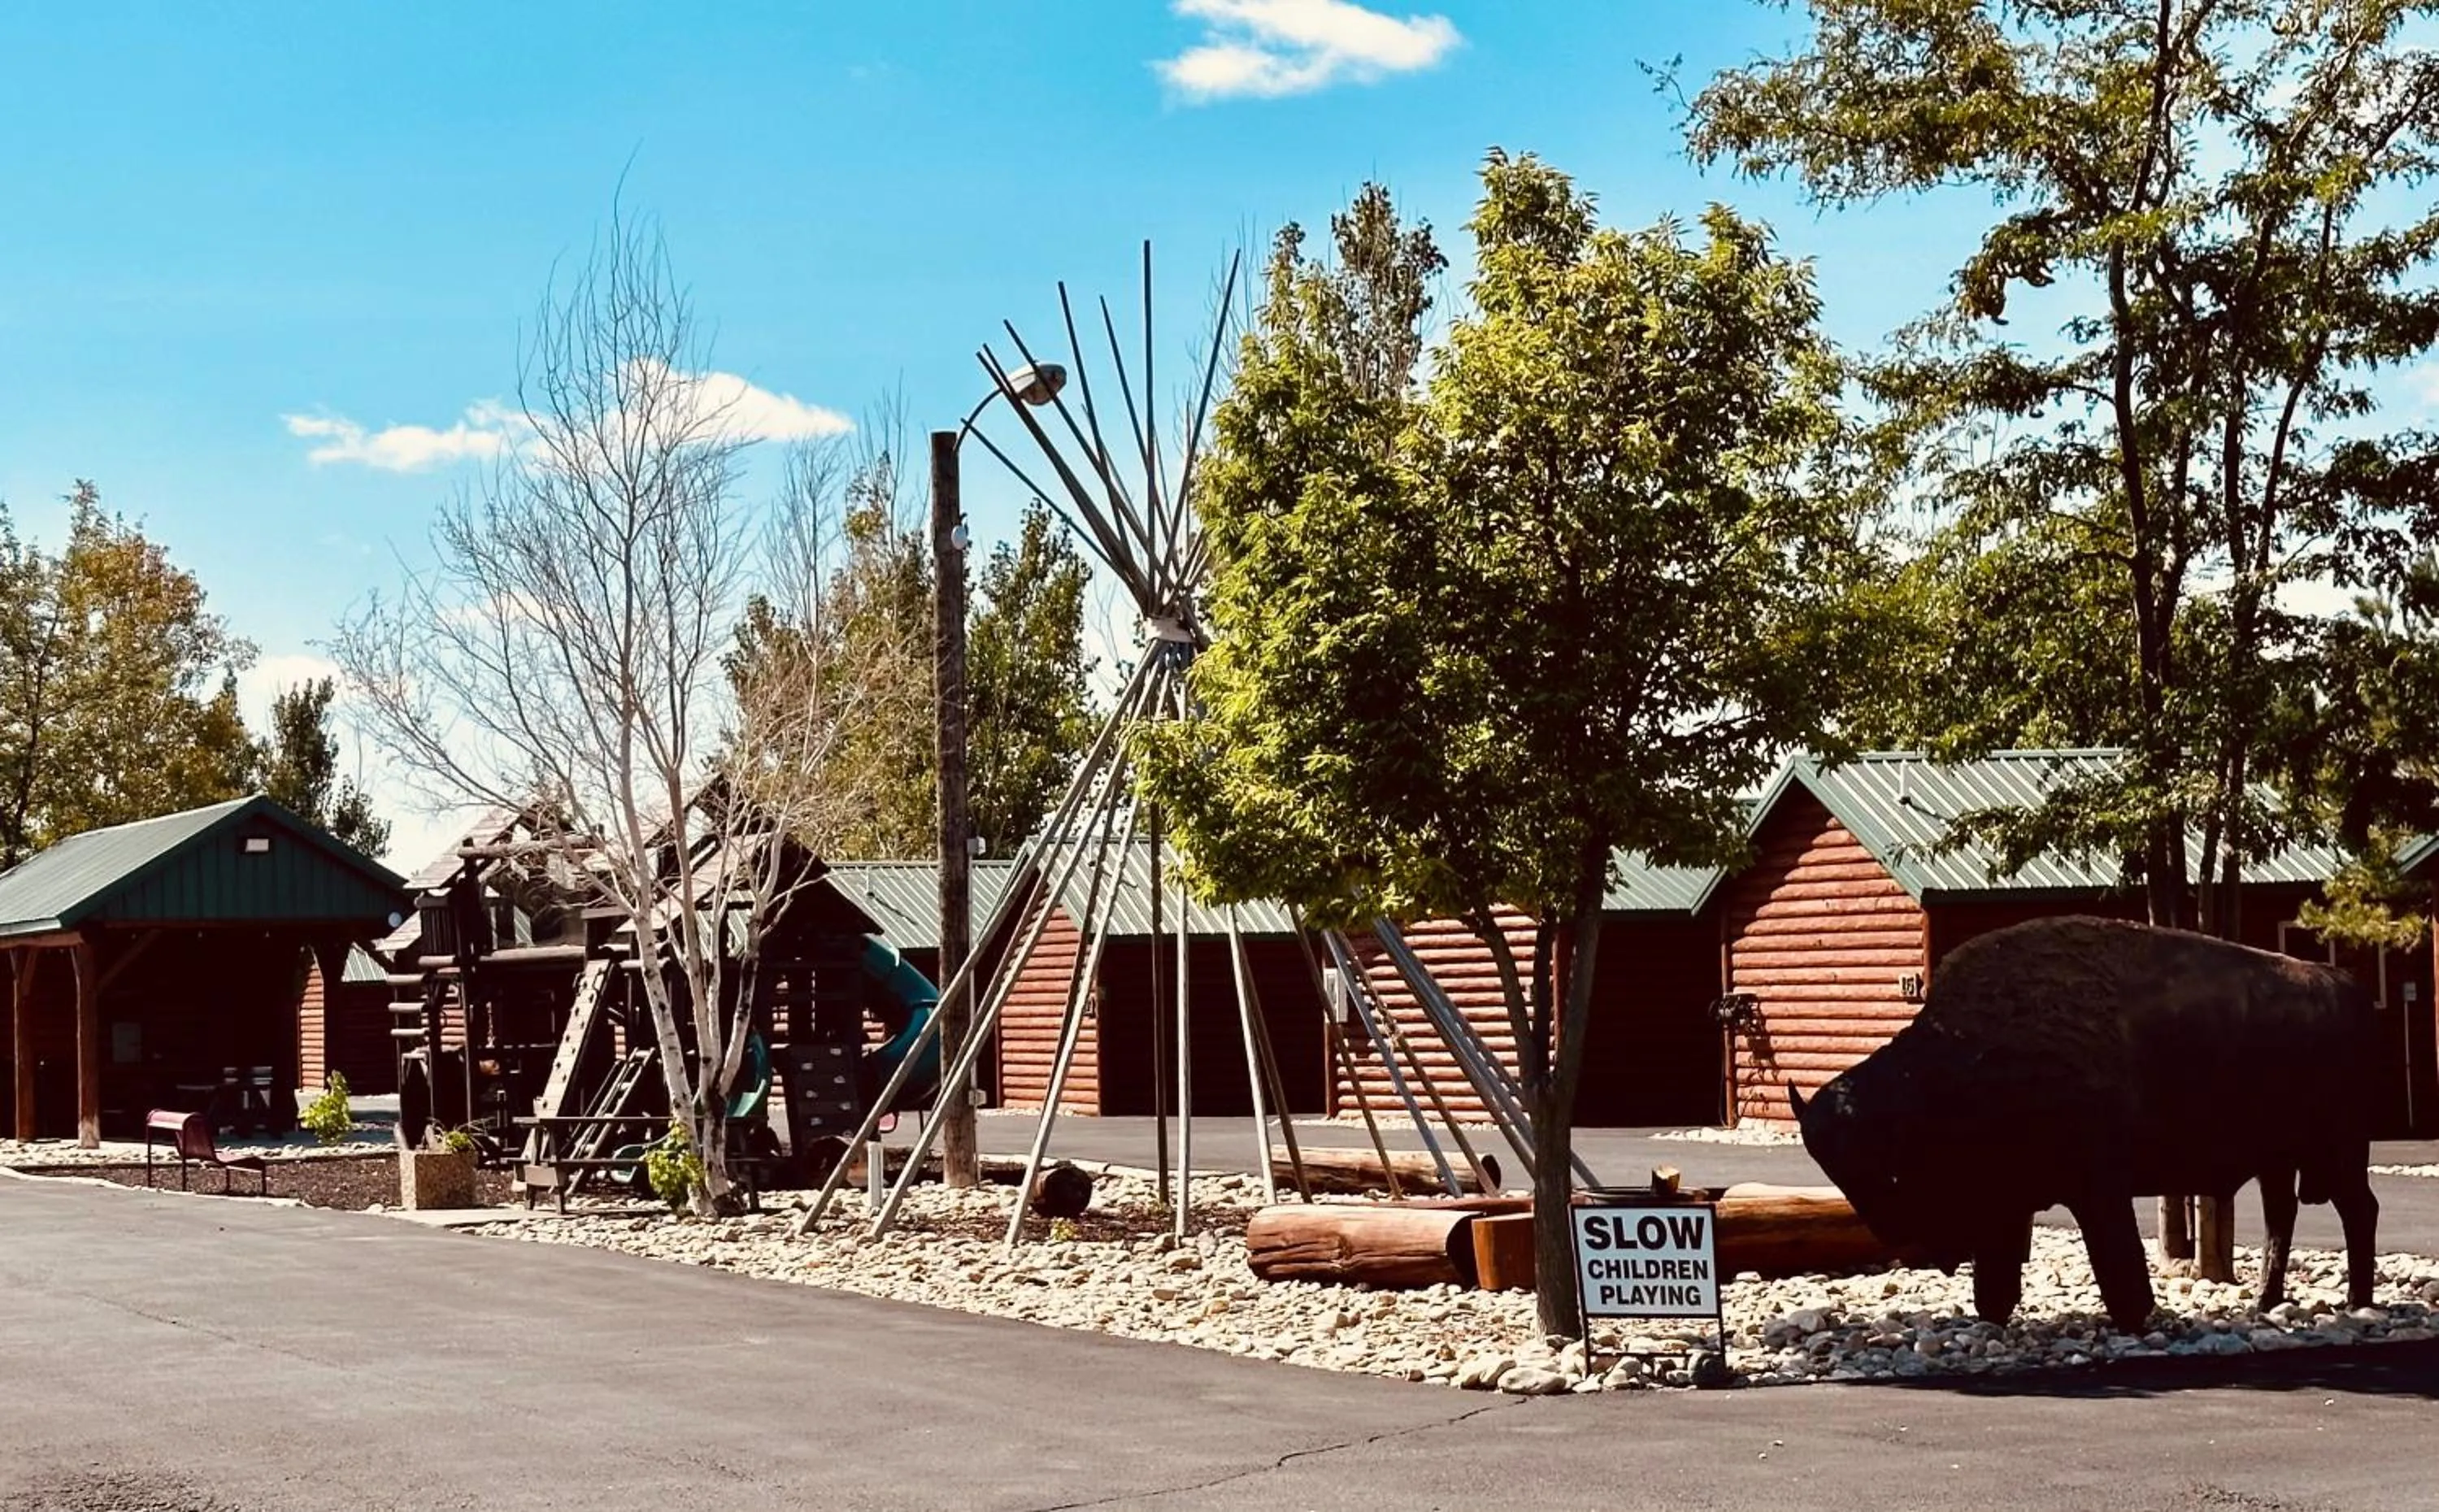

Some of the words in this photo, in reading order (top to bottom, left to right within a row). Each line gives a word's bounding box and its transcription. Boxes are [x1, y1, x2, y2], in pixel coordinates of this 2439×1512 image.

[1584, 1215, 1705, 1250] SLOW
[1588, 1259, 1709, 1280] CHILDREN
[1600, 1285, 1702, 1306] PLAYING
